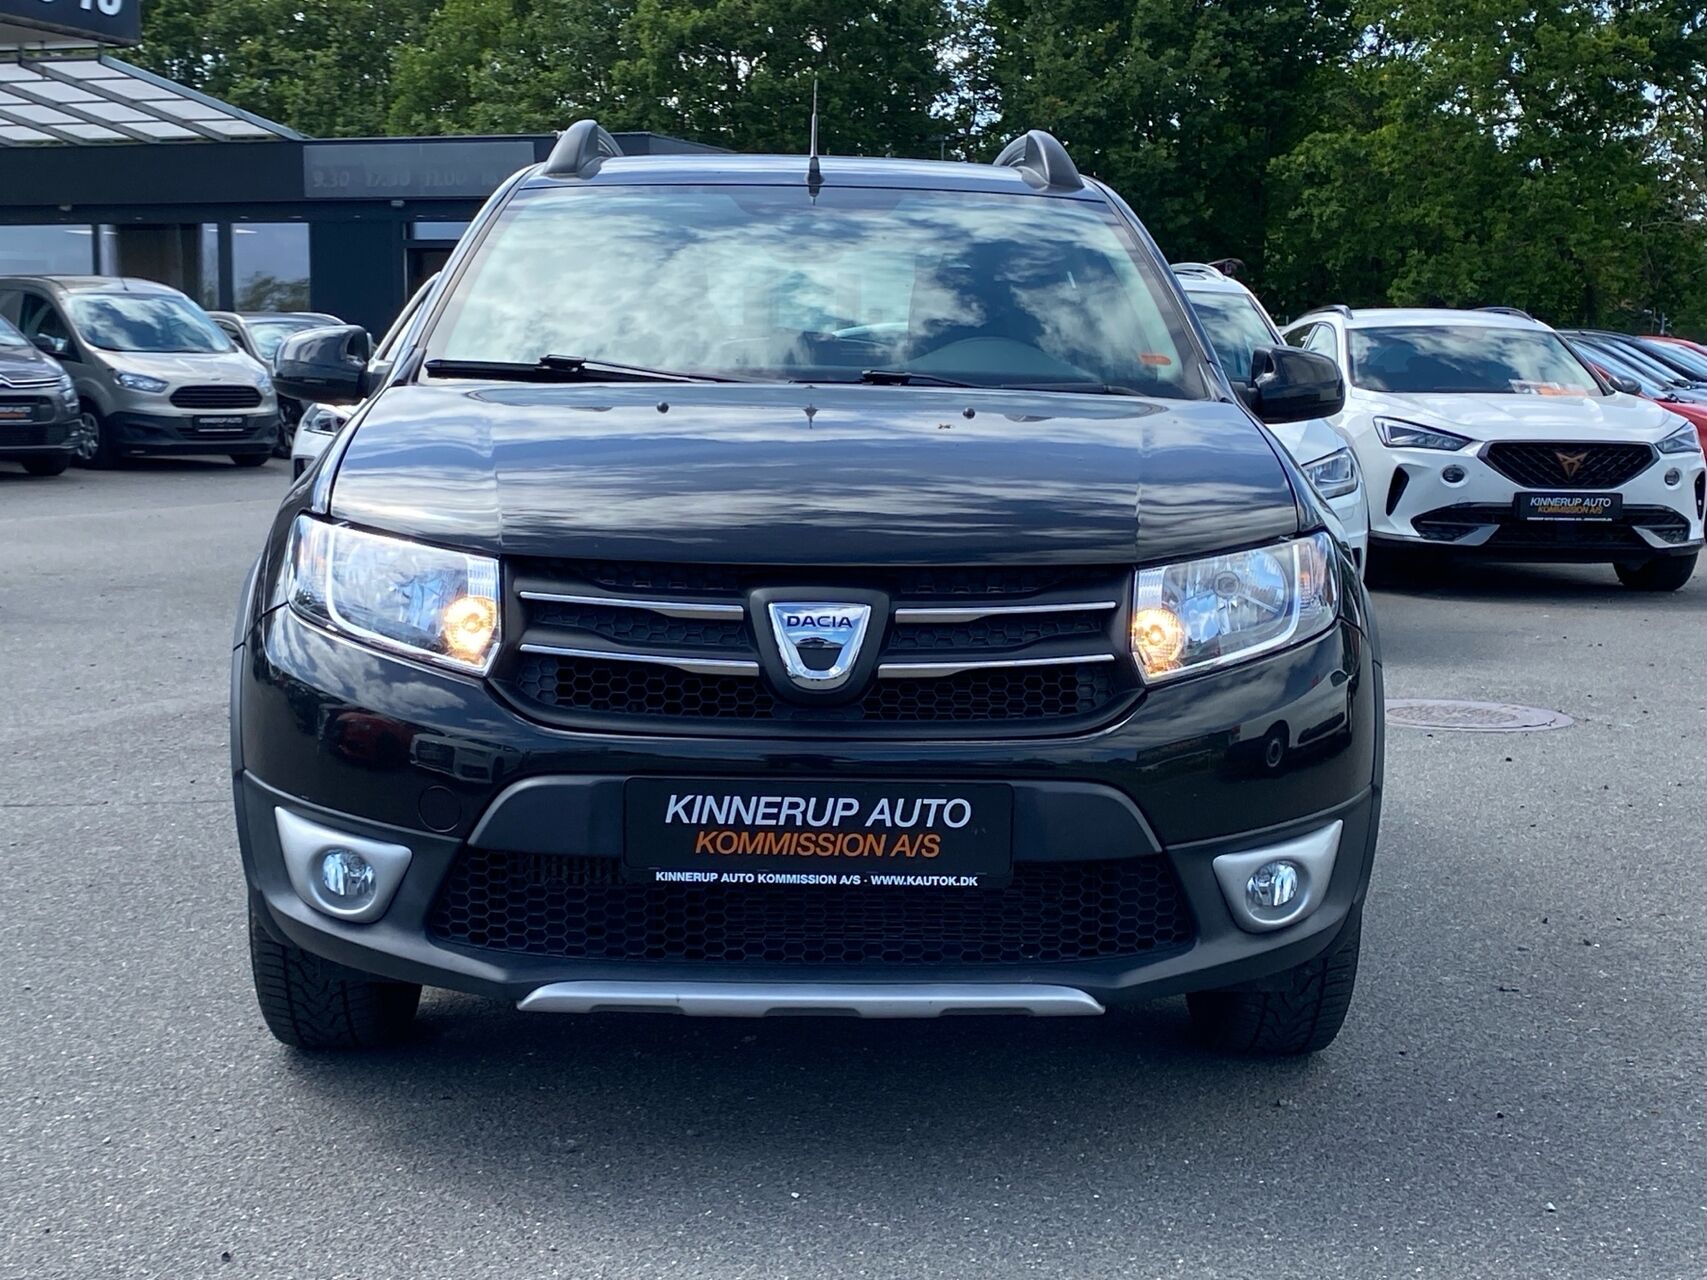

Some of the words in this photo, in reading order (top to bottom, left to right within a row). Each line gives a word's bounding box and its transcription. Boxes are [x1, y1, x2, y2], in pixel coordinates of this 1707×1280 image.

[1530, 497, 1582, 507] KINNERUP
[1583, 498, 1611, 507] AUTO
[786, 615, 853, 629] DACIA
[665, 794, 859, 828] KINNERUP
[865, 797, 972, 829] AUTO
[695, 831, 887, 857] KOMMISSION
[889, 834, 942, 858] A/S
[655, 871, 718, 883] KINNERUP
[720, 873, 755, 883] AUTO
[757, 873, 837, 885] KOMMISSION
[839, 874, 861, 885] A/S
[870, 875, 978, 887] WWW.KAUTOK.DK
